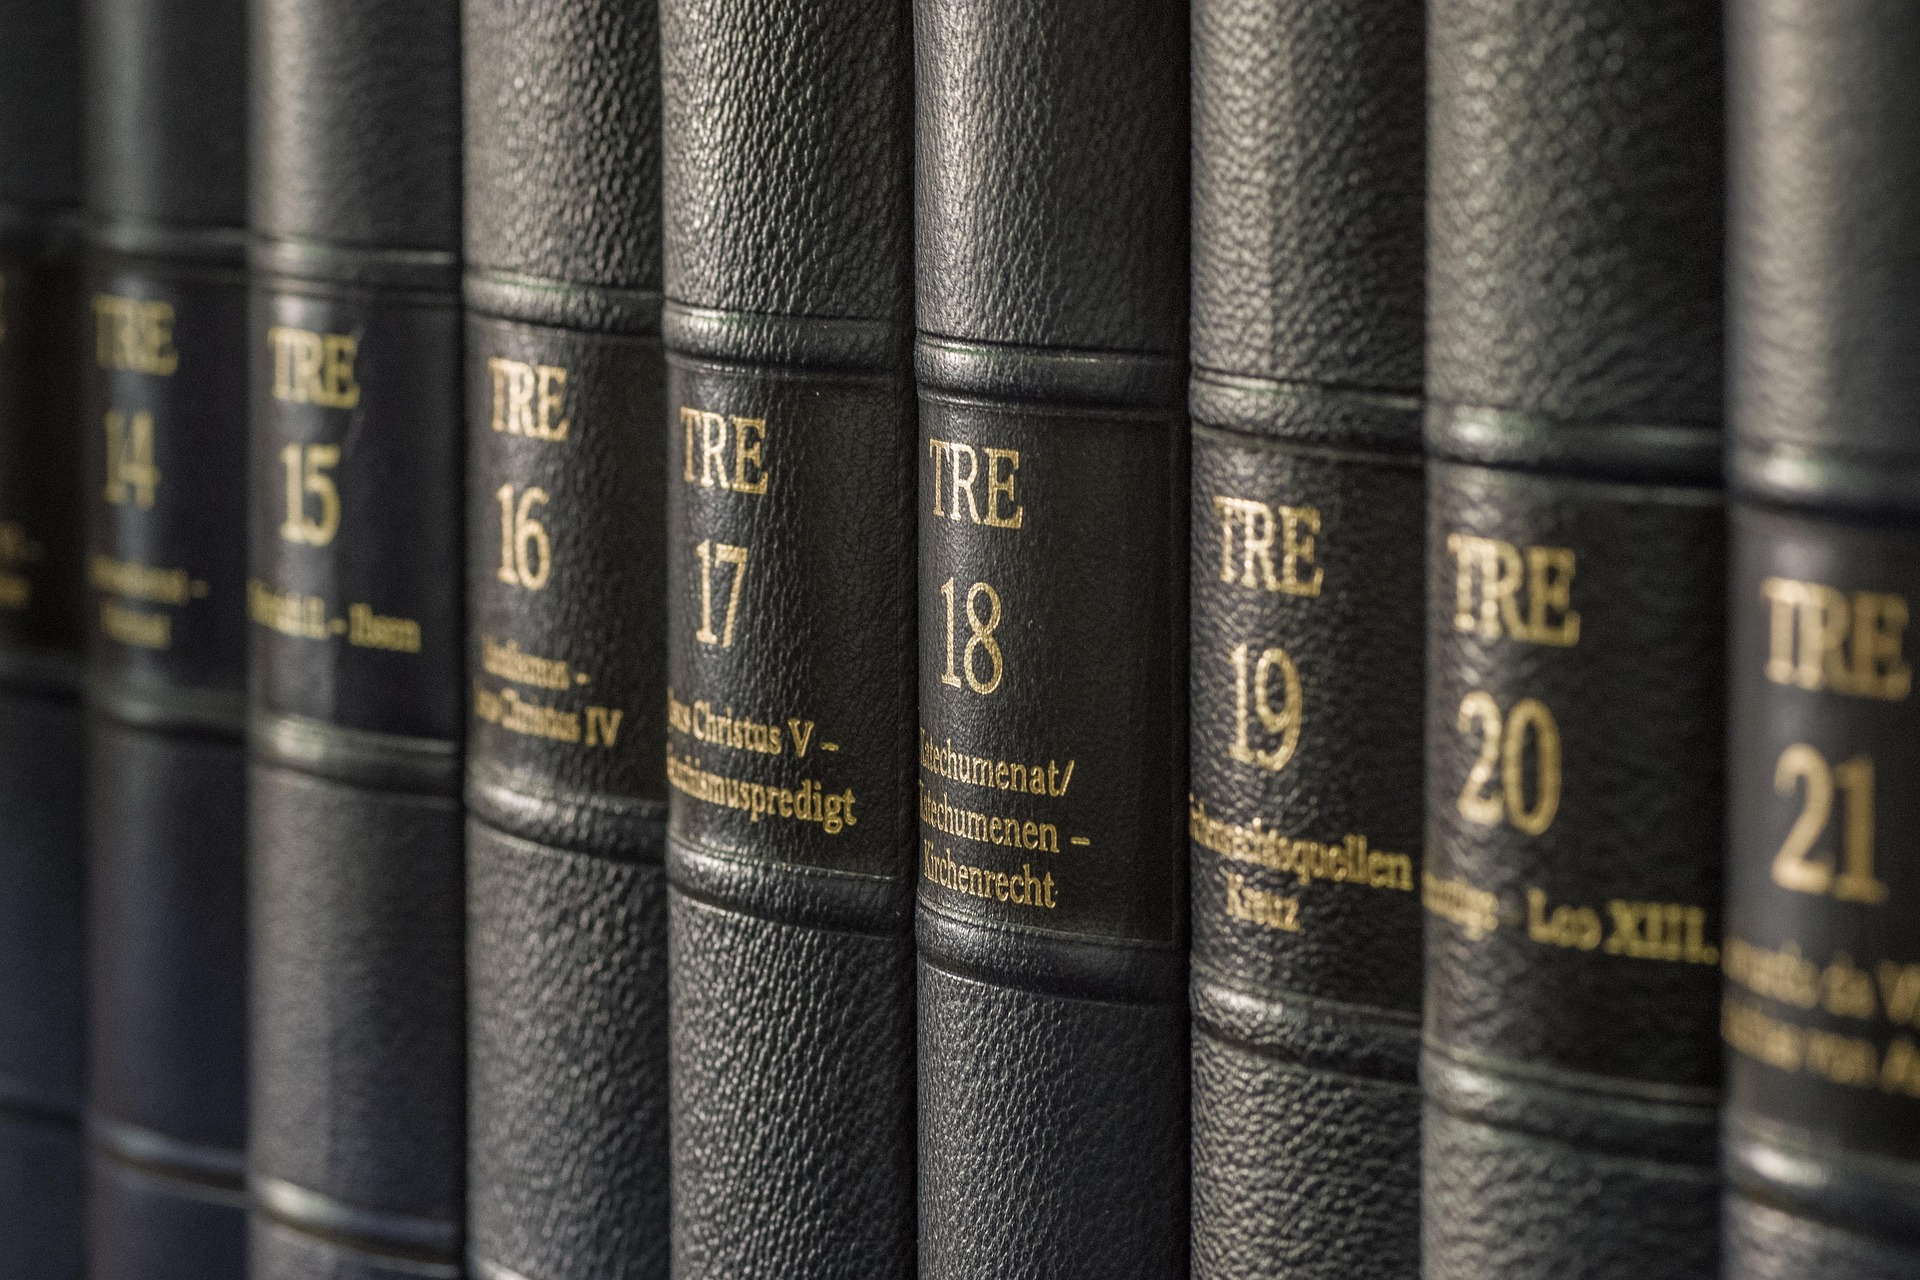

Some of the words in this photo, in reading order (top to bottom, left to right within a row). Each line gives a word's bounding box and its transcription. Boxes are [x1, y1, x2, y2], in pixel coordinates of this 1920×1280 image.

[93, 294, 178, 376] TRE
[268, 326, 360, 410] TRE
[487, 357, 570, 441] TRE
[105, 410, 160, 511] 14
[281, 443, 341, 547] 15
[679, 406, 769, 494] TRE
[929, 438, 1023, 529] TRE
[496, 483, 551, 592] 16
[1214, 496, 1324, 597] TRE
[696, 539, 749, 648] 17
[940, 576, 1003, 695] 18
[1447, 533, 1581, 647] TRE
[1761, 576, 1911, 700] TRE
[585, 706, 624, 748] IV
[693, 698, 782, 755] Christus
[787, 717, 815, 758] V
[1229, 642, 1303, 772] 19
[1458, 690, 1562, 835] 20
[923, 838, 1056, 909] Kirchenrecht
[1772, 742, 1886, 905] 21
